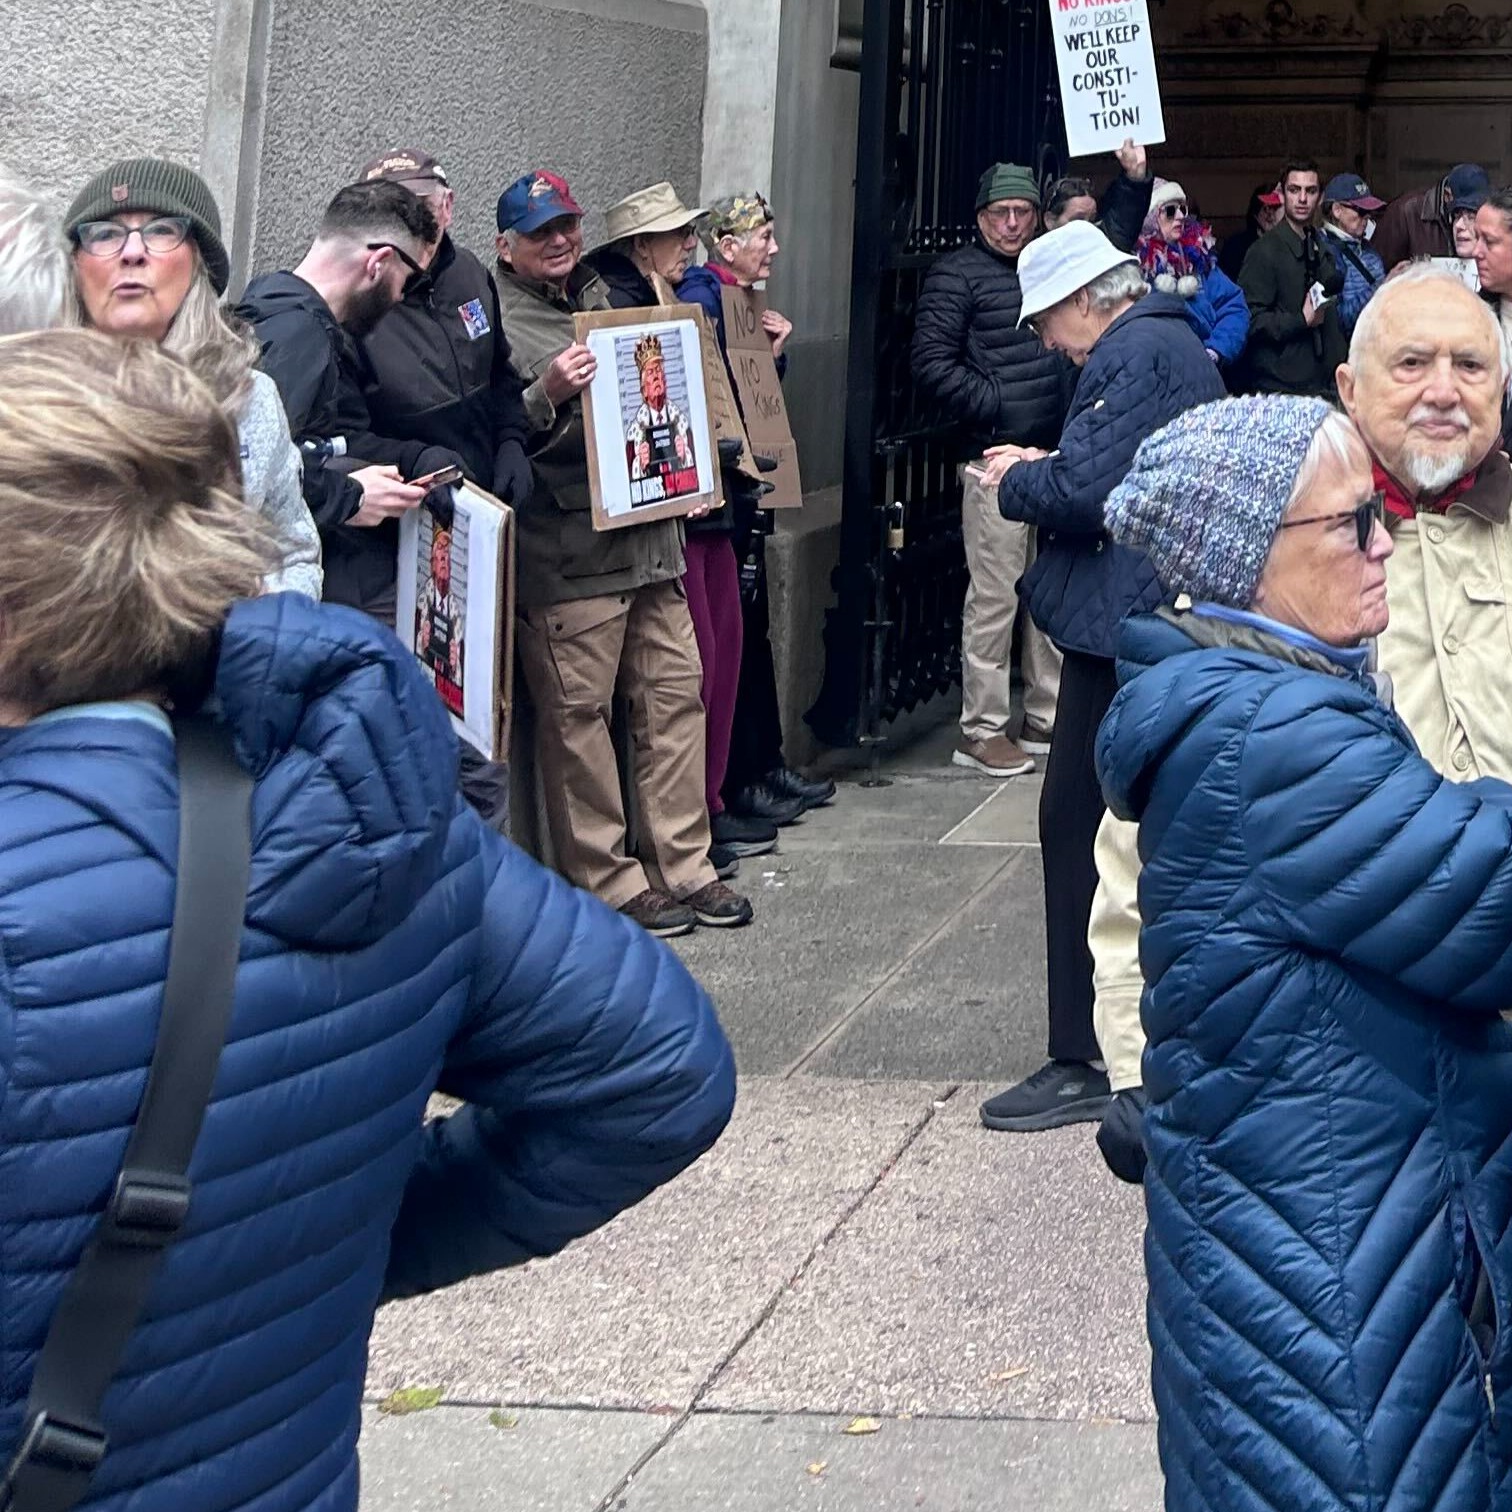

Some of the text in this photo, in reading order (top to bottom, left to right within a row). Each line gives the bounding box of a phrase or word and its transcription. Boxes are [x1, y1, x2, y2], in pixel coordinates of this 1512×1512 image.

[1069, 14, 1088, 28] NO
[1106, 24, 1140, 46] KEEP
[1086, 48, 1119, 68] OUR
[1073, 66, 1138, 92] CONSTI-
[1097, 89, 1127, 109] TU-
[733, 300, 756, 339] NO
[739, 355, 761, 387] NO
